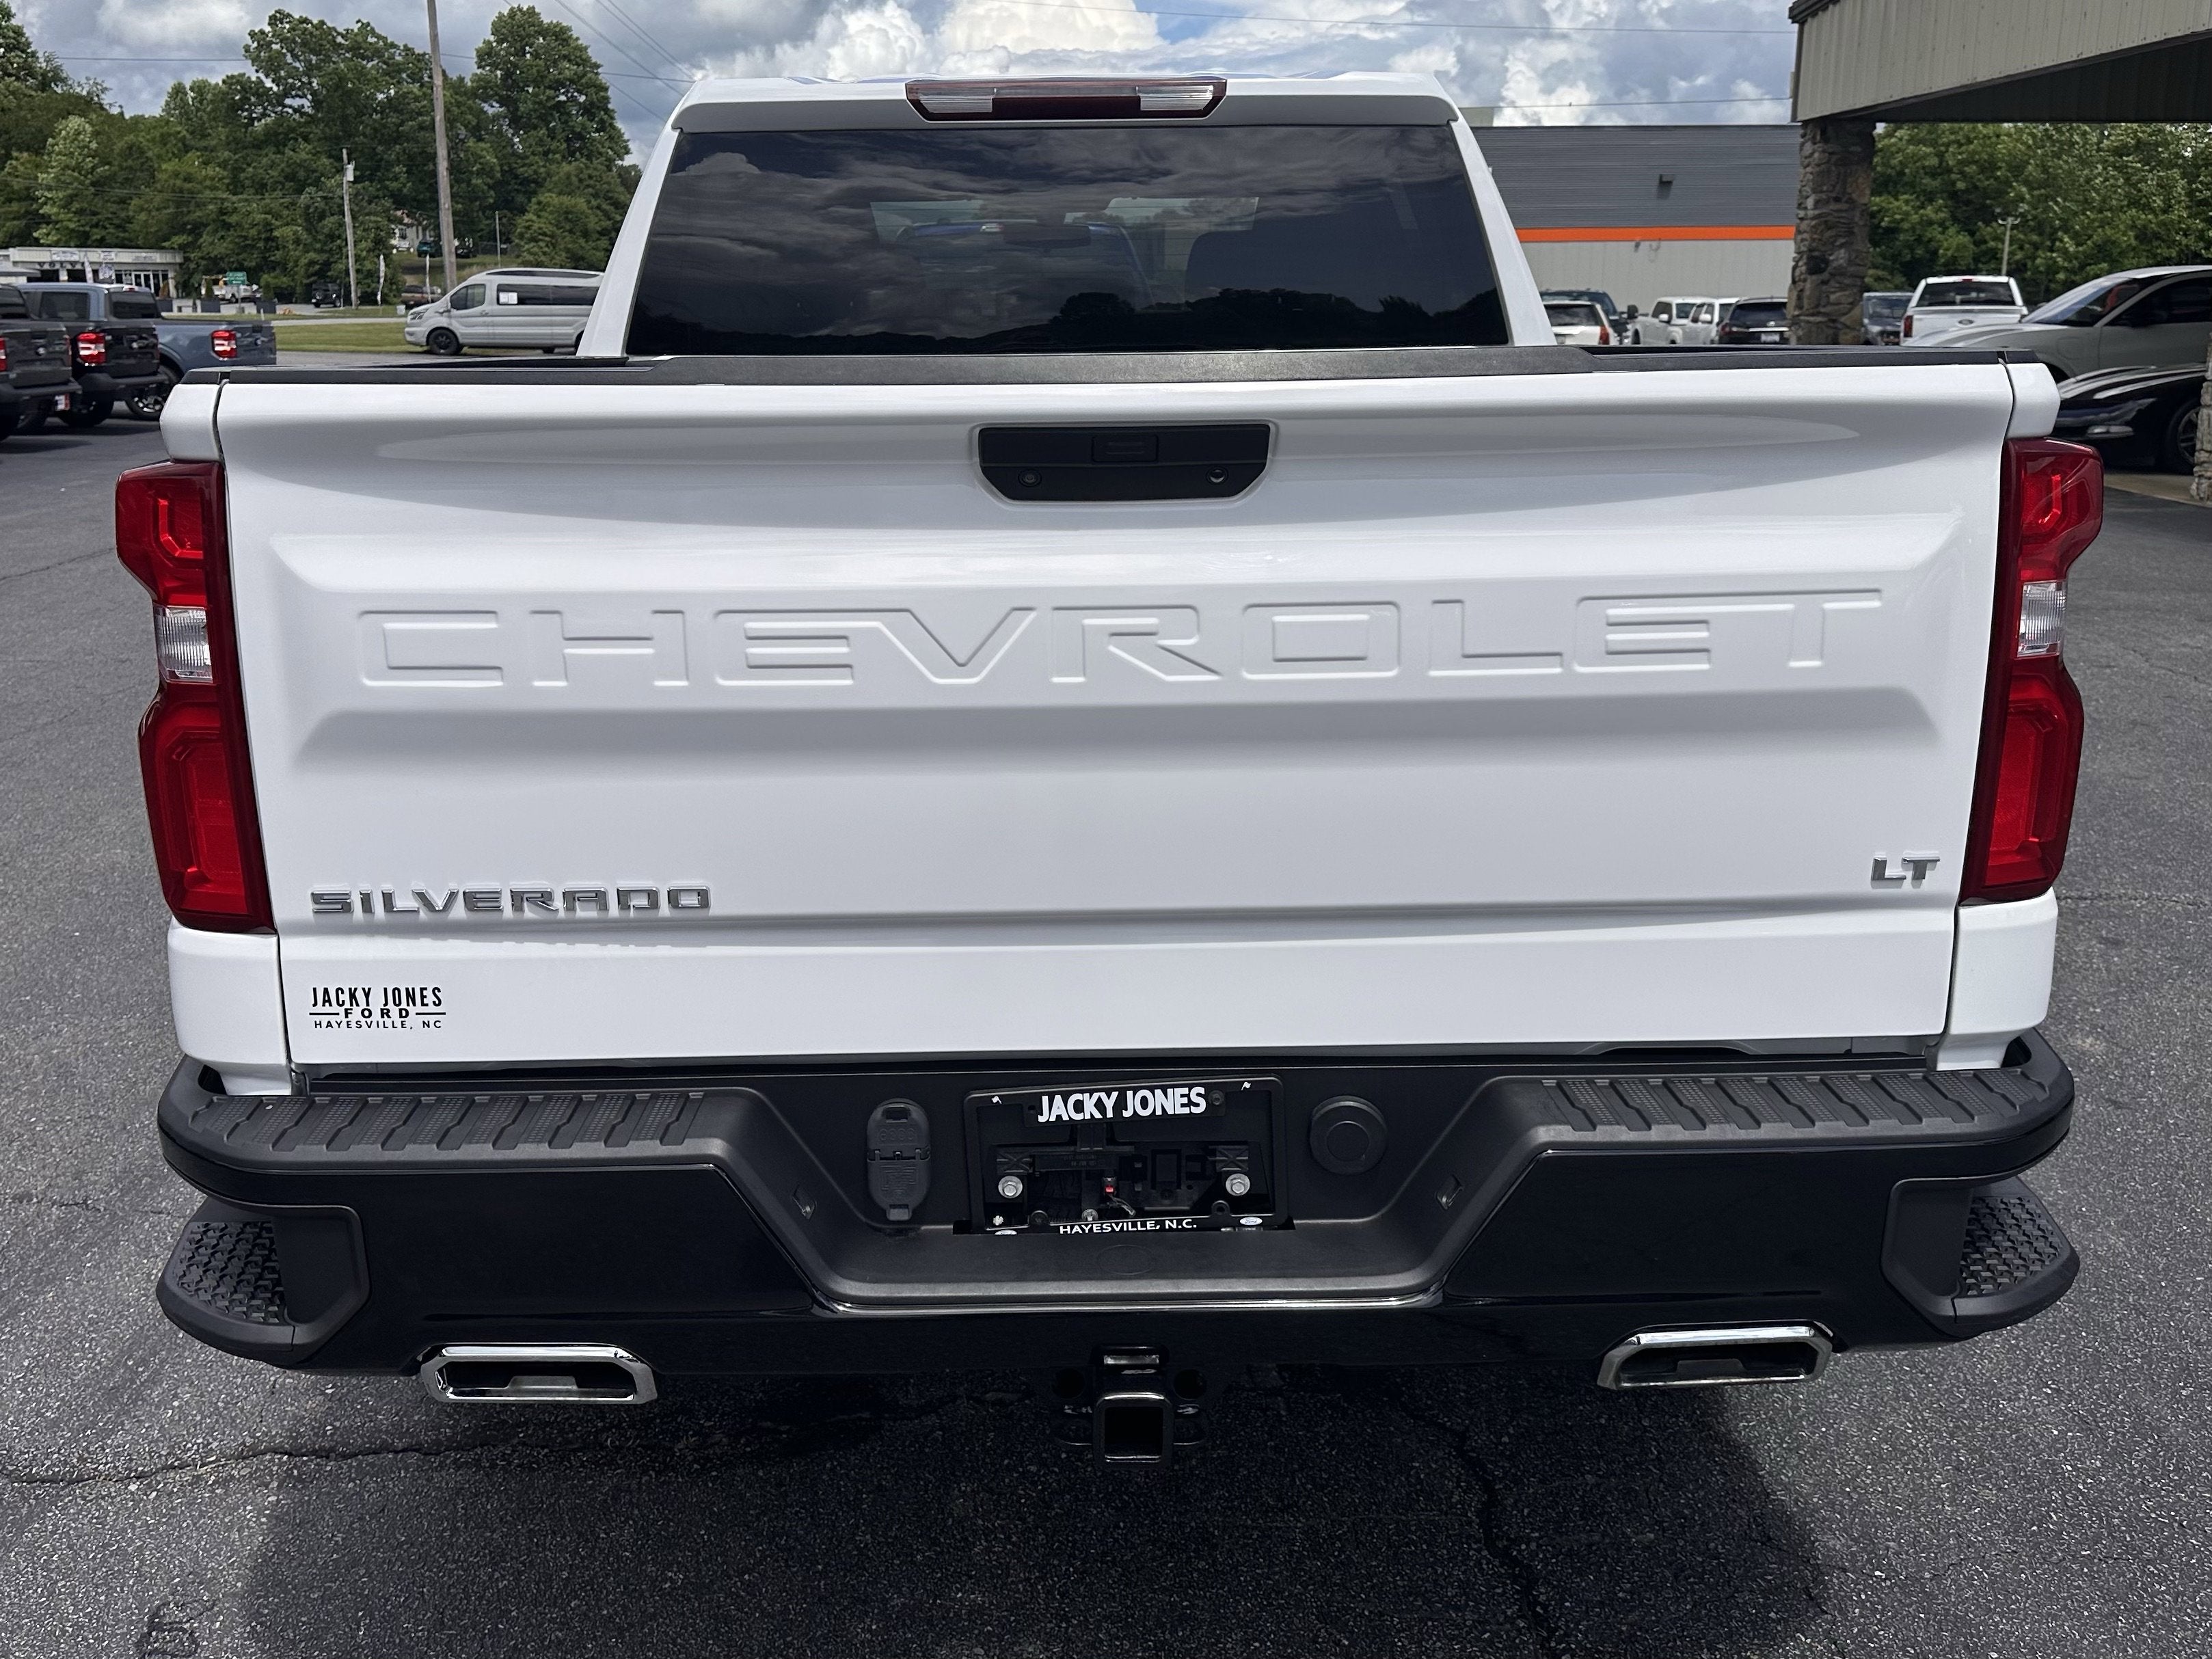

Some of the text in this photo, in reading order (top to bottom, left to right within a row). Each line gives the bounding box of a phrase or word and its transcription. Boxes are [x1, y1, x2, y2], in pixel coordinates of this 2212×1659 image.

[358, 589, 1883, 686] CHEVROLET
[1870, 857, 1941, 881] LT
[311, 886, 711, 913] SILVERADO
[312, 986, 442, 1007] JACKY JONES
[314, 1020, 442, 1029] HAYESVILLE, NC
[344, 1008, 409, 1019] FORD
[1038, 1086, 1206, 1122] JACKY JONES
[1060, 1219, 1197, 1235] HAYESVILLE, N.C.
